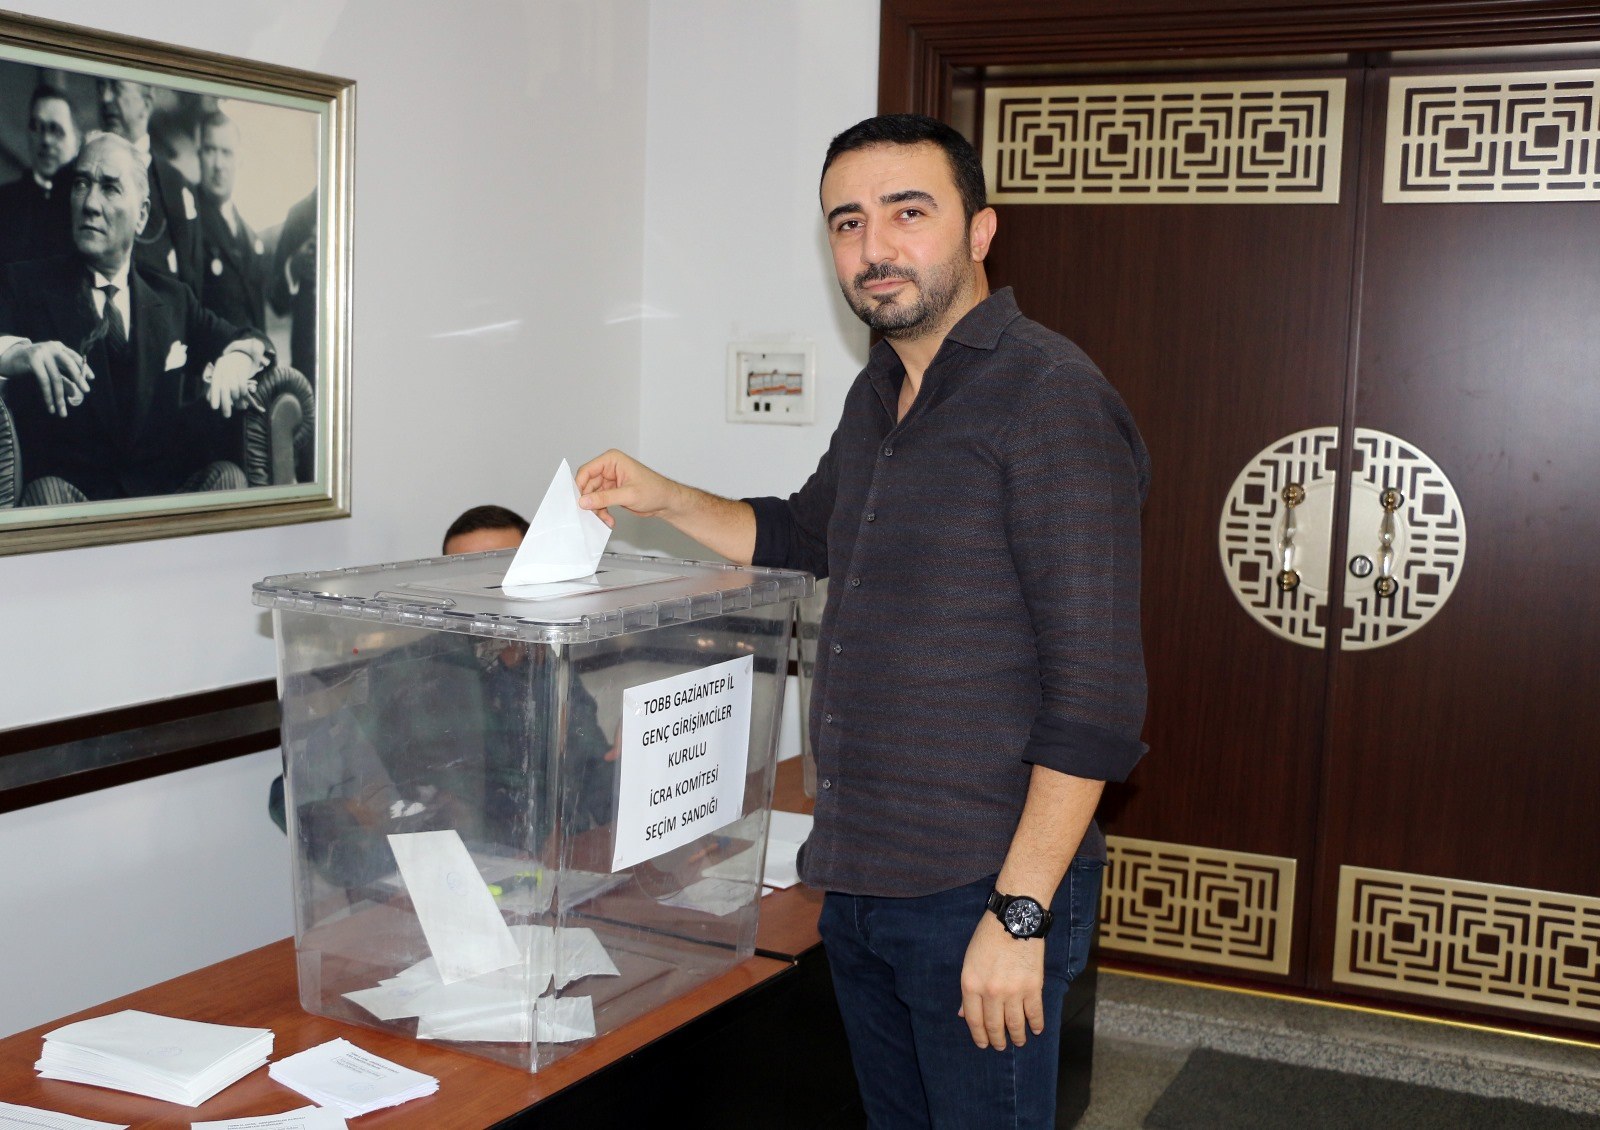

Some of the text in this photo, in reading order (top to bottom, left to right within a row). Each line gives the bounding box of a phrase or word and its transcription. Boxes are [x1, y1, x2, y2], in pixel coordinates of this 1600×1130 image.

[644, 673, 735, 716] TOBB GAZİANTEP İL
[642, 704, 732, 746] GENÇ GİRİŞİMCİLER
[668, 741, 707, 768] KURULU
[649, 764, 719, 807] İCRA KOMİTESİ
[645, 796, 718, 841] SEÇİM SANDIĞI
